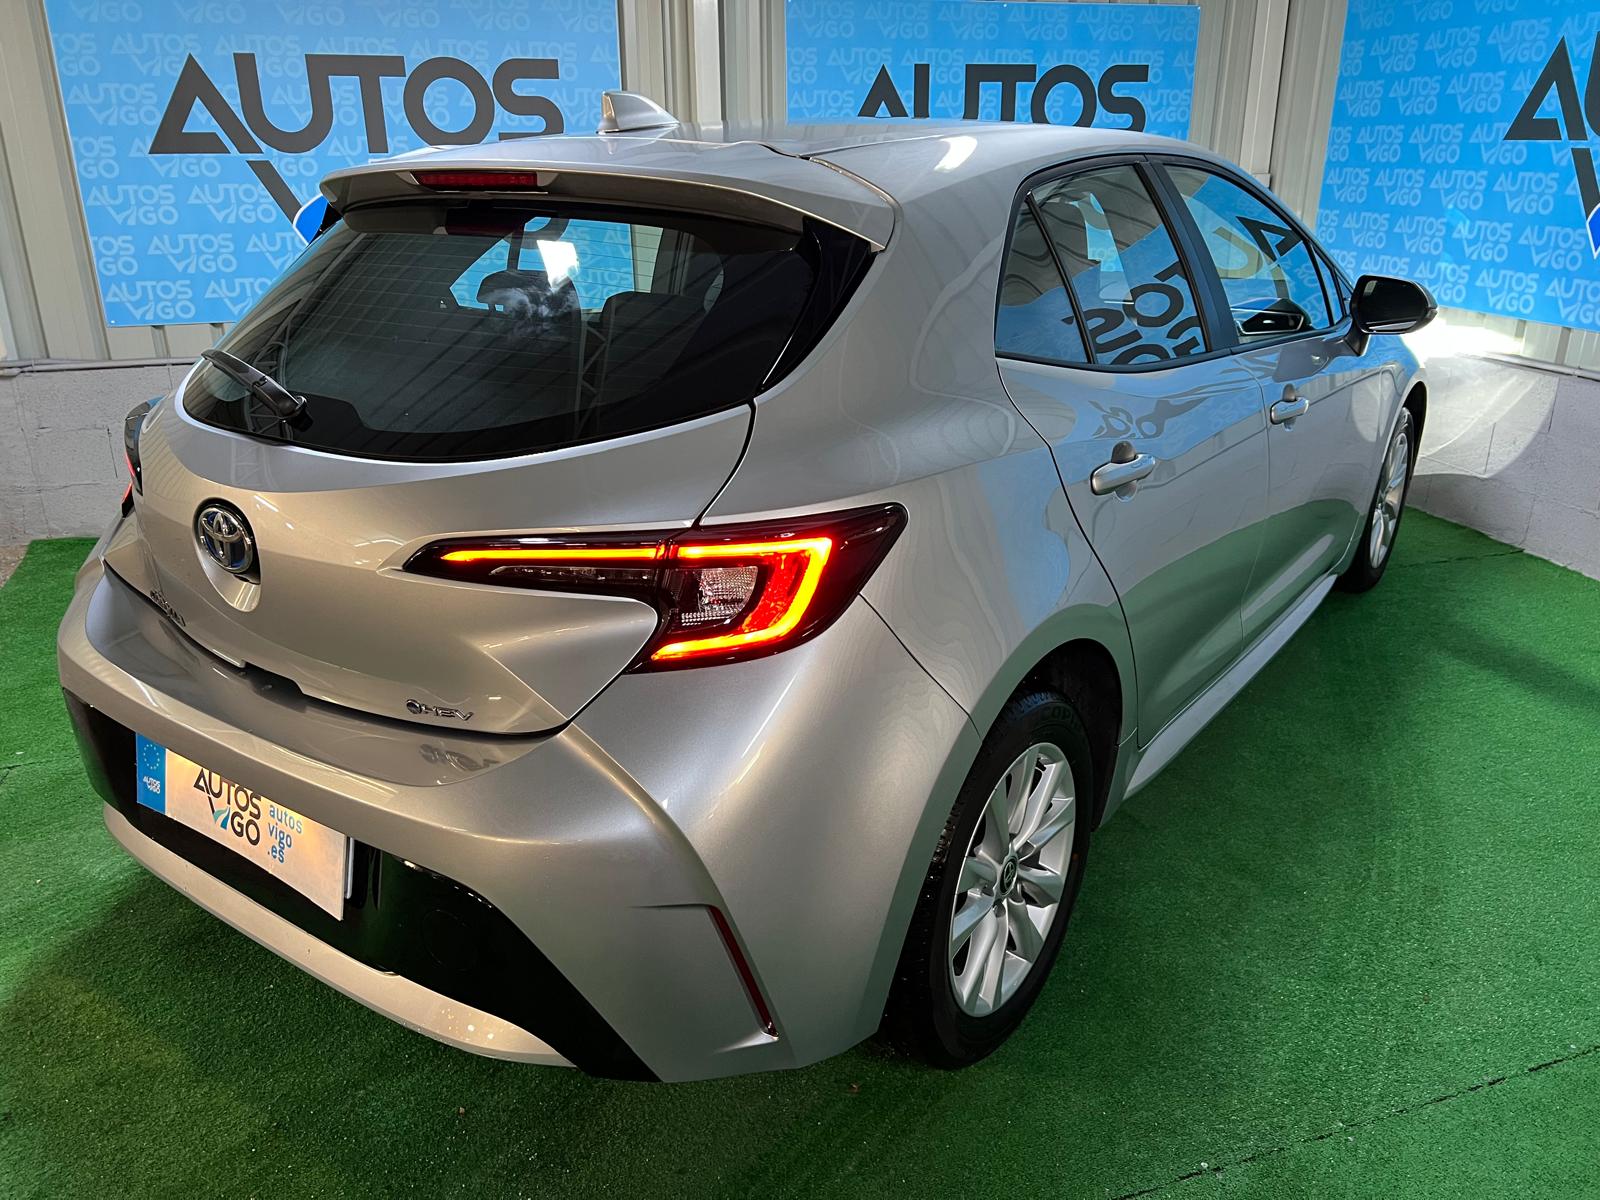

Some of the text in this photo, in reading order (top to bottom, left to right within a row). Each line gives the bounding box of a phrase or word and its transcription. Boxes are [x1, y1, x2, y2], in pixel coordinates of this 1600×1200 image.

[1424, 26, 1481, 51] AUTOS
[1487, 17, 1552, 45] AUTOS
[1435, 47, 1477, 69] VIGO
[1498, 40, 1547, 64] VIGO
[1339, 80, 1384, 100] AUTOS
[1389, 75, 1442, 97] AUTOS
[1446, 70, 1506, 95] AUTOS
[148, 52, 565, 155] AUTOS
[1347, 99, 1380, 118] VIGO
[1398, 95, 1437, 116] VIGO
[1457, 91, 1501, 115] VIGO
[1356, 125, 1404, 143] AUTOS
[1408, 123, 1464, 143] AUTOS
[1365, 144, 1400, 163] VIGO
[1418, 143, 1460, 164] VIGO
[1481, 143, 1527, 165] VIGO
[1326, 167, 1371, 185] AUTOS
[1374, 168, 1425, 187] AUTOS
[1429, 169, 1488, 191] AUTOS
[1493, 171, 1559, 194] AUTOS
[87, 184, 176, 206] AUTOS
[1334, 185, 1367, 203] VIGO
[1383, 187, 1421, 207] VIGO
[1440, 189, 1483, 211] VIGO
[1505, 191, 1554, 215] VIGO
[106, 204, 179, 225] VIGO
[207, 204, 277, 224] VIGO
[1342, 211, 1390, 231] AUTOS
[1393, 215, 1447, 237] AUTOS
[1452, 220, 1513, 243] AUTOS
[148, 233, 235, 255] AUTOS
[1352, 229, 1386, 249] VIGO
[1403, 233, 1443, 255] VIGO
[1518, 225, 1586, 250] AUTOS
[1463, 240, 1508, 263] VIGO
[1531, 246, 1582, 271] VIGO
[167, 253, 238, 274] VIGO
[1361, 253, 1410, 275] AUTOS
[1414, 260, 1471, 284] AUTOS
[105, 280, 193, 302] AUTOS
[1475, 268, 1540, 294] AUTOS
[124, 299, 197, 321] VIGO
[1487, 288, 1535, 314] VIGO
[193, 768, 262, 820] AUTOS
[207, 795, 261, 846] VIGO
[269, 803, 303, 834] autos
[268, 822, 293, 850] vigo
